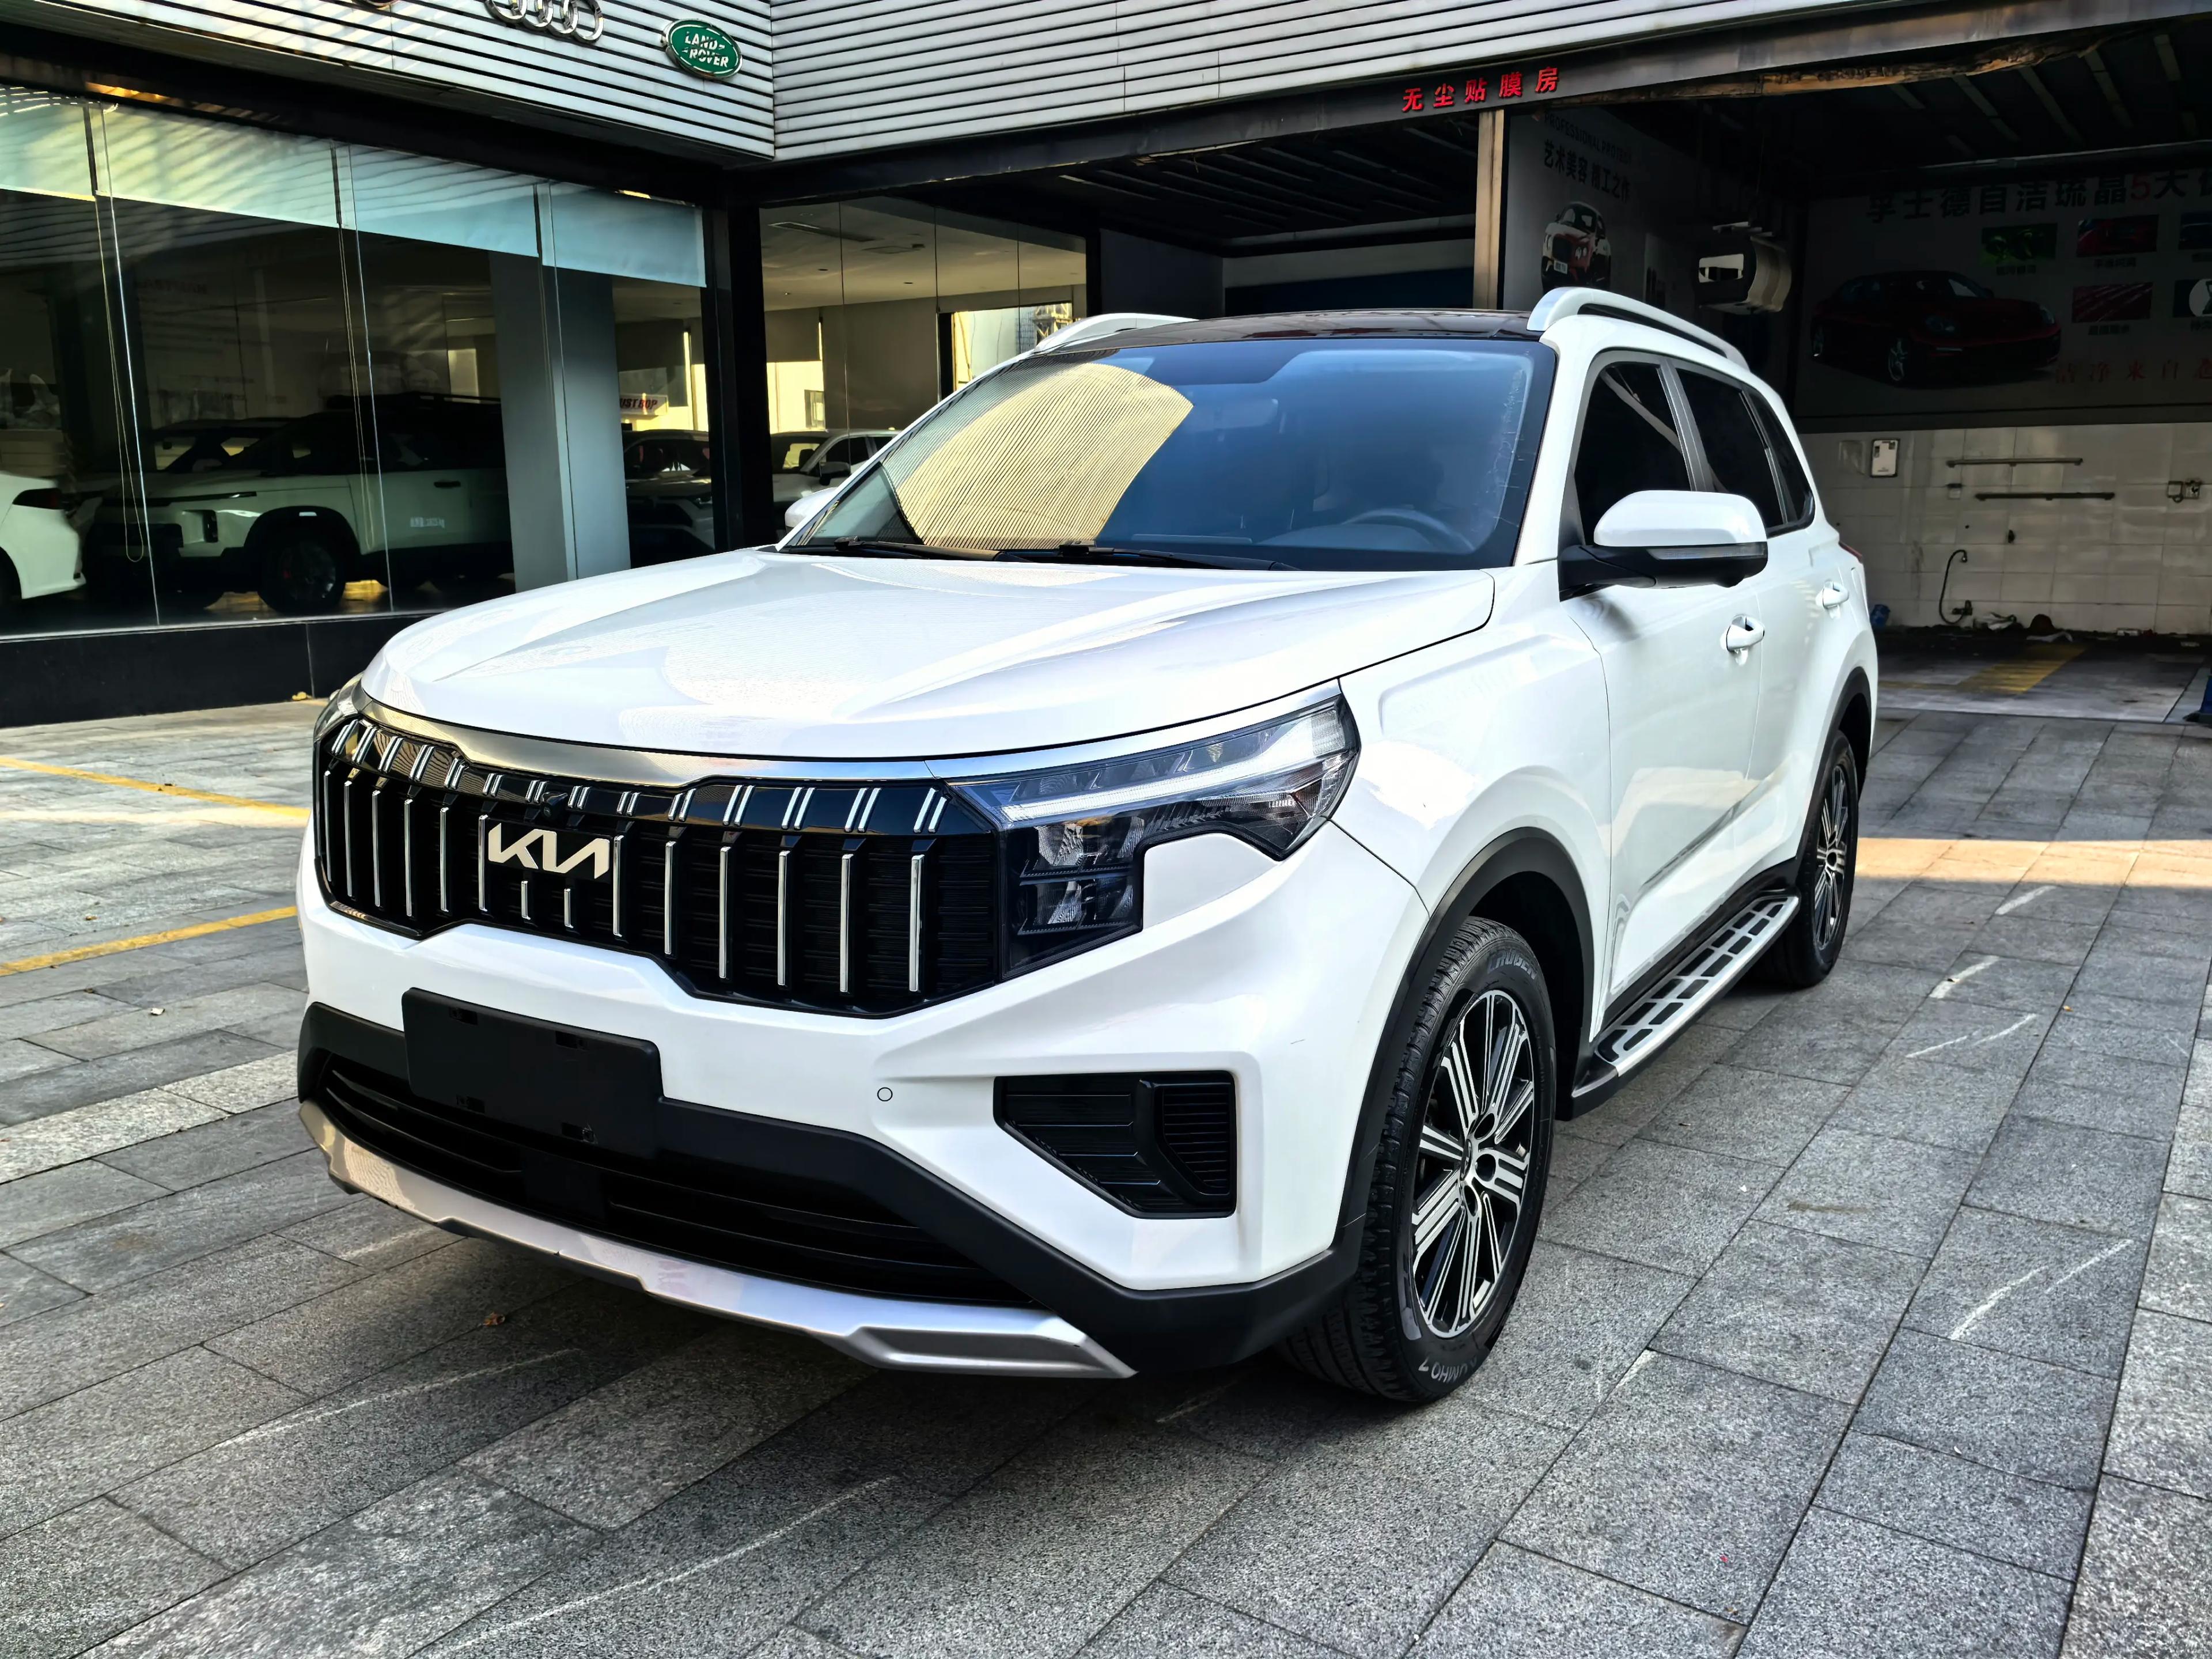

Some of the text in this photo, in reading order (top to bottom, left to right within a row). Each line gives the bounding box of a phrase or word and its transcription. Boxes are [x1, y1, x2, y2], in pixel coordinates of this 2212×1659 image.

[684, 31, 718, 50] LAND
[689, 48, 729, 68] ROVER
[1402, 66, 1559, 112] 无尘贴膜房
[1544, 112, 1600, 152] PROFESSIONAL
[1544, 139, 1588, 184] 艺术美容
[488, 823, 610, 879] KIA
[1487, 949, 1537, 980] CRUGEN
